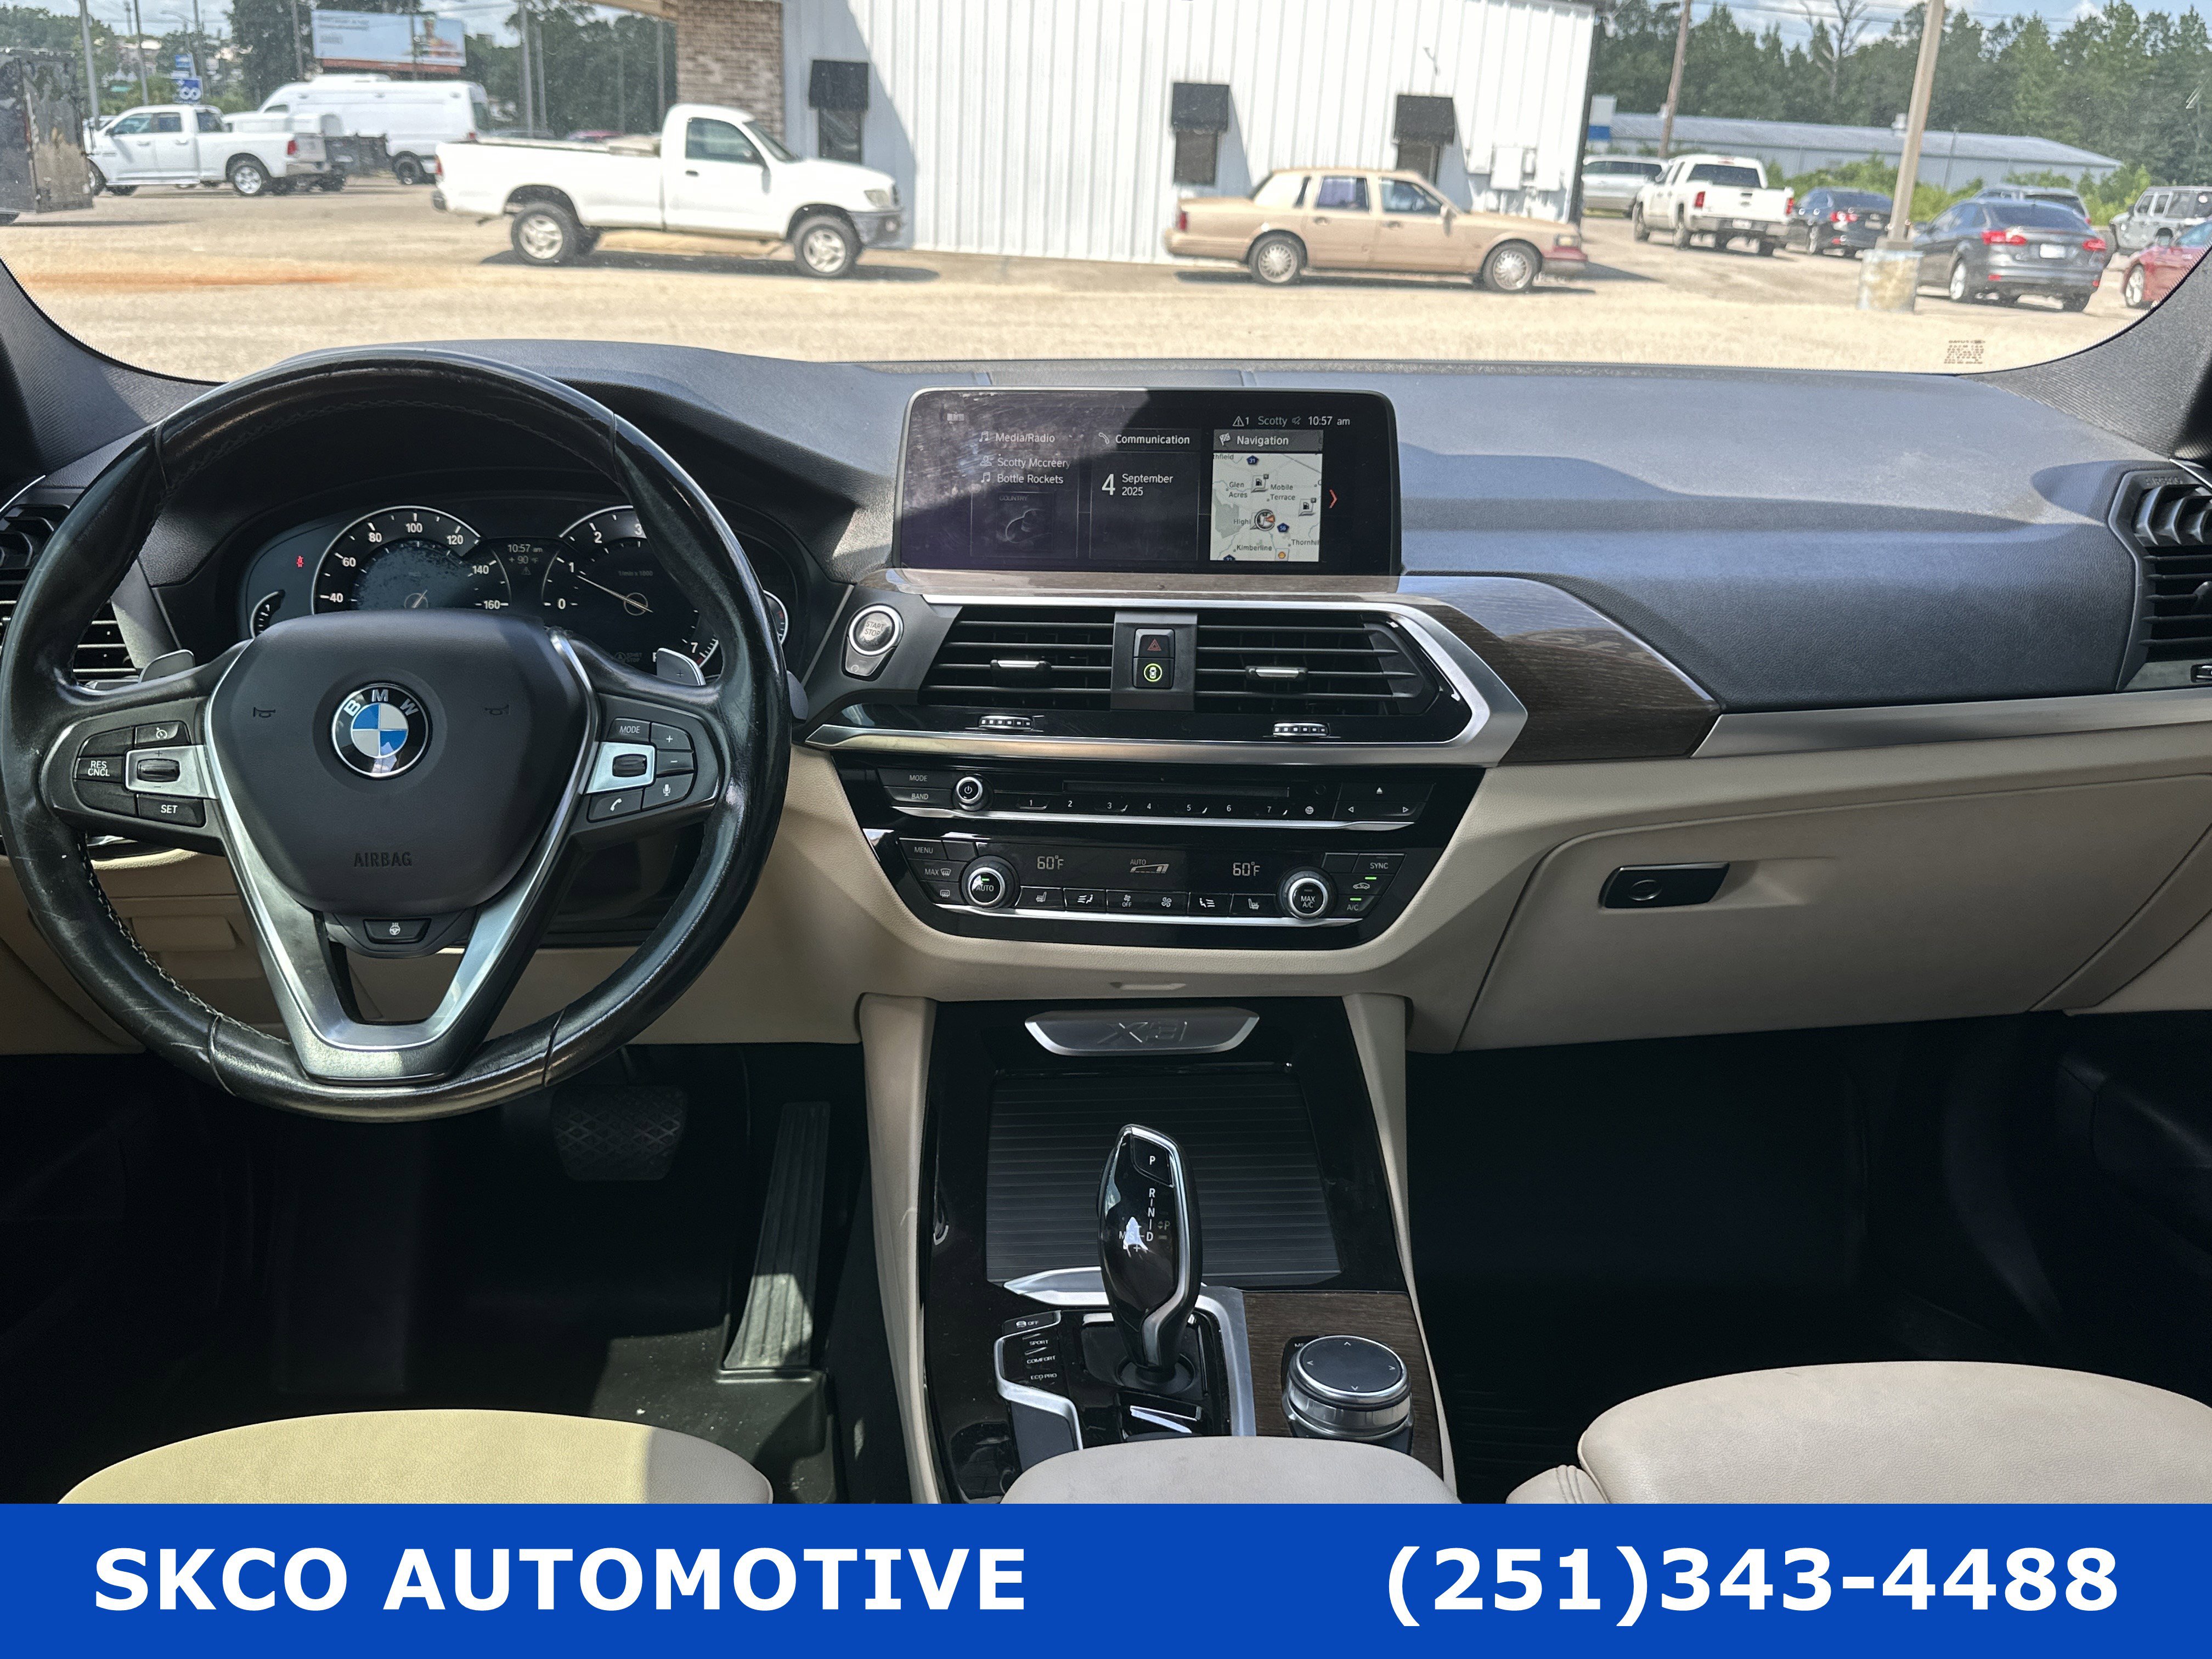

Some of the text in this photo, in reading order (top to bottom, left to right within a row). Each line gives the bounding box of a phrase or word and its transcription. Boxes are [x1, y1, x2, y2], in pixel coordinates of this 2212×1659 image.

[1245, 416, 1249, 425] 1
[1258, 416, 1288, 426] Scotty
[1308, 416, 1333, 426] 10:57
[996, 432, 1056, 443] Media/Radio
[1115, 435, 1190, 444] Communication
[1237, 436, 1289, 447] Navigation
[997, 457, 1070, 470] Scotty Mccreery
[997, 474, 1064, 484] Bottle Rockets
[1122, 473, 1173, 484] September
[1102, 473, 1116, 496] 4
[1121, 487, 1143, 496] 2025
[405, 523, 423, 534] 100
[634, 524, 642, 535] 3
[368, 532, 383, 543] 80
[446, 534, 464, 545] 120
[594, 531, 602, 543] 2
[507, 544, 531, 553] 10:57
[342, 557, 357, 568] 60
[517, 555, 529, 565] 90
[472, 565, 489, 575] 140
[569, 562, 574, 573] 1
[330, 592, 343, 603] 40
[483, 600, 500, 610] 160
[557, 599, 566, 610] 0
[866, 621, 885, 629] START
[691, 642, 698, 653] 7
[343, 689, 419, 716] BMW
[619, 725, 641, 734] MODE
[91, 760, 107, 769] RES
[87, 769, 110, 777] CNCL
[160, 804, 178, 814] SET
[354, 851, 412, 867] AIRBAG
[1037, 855, 1064, 870] 60°F
[1232, 861, 1261, 877] 60°F
[1149, 1155, 1156, 1165] P
[1149, 1188, 1156, 1198] R
[1148, 1207, 1155, 1217] N
[1146, 1232, 1154, 1242] D
[1026, 1355, 1056, 1364] COMFORT
